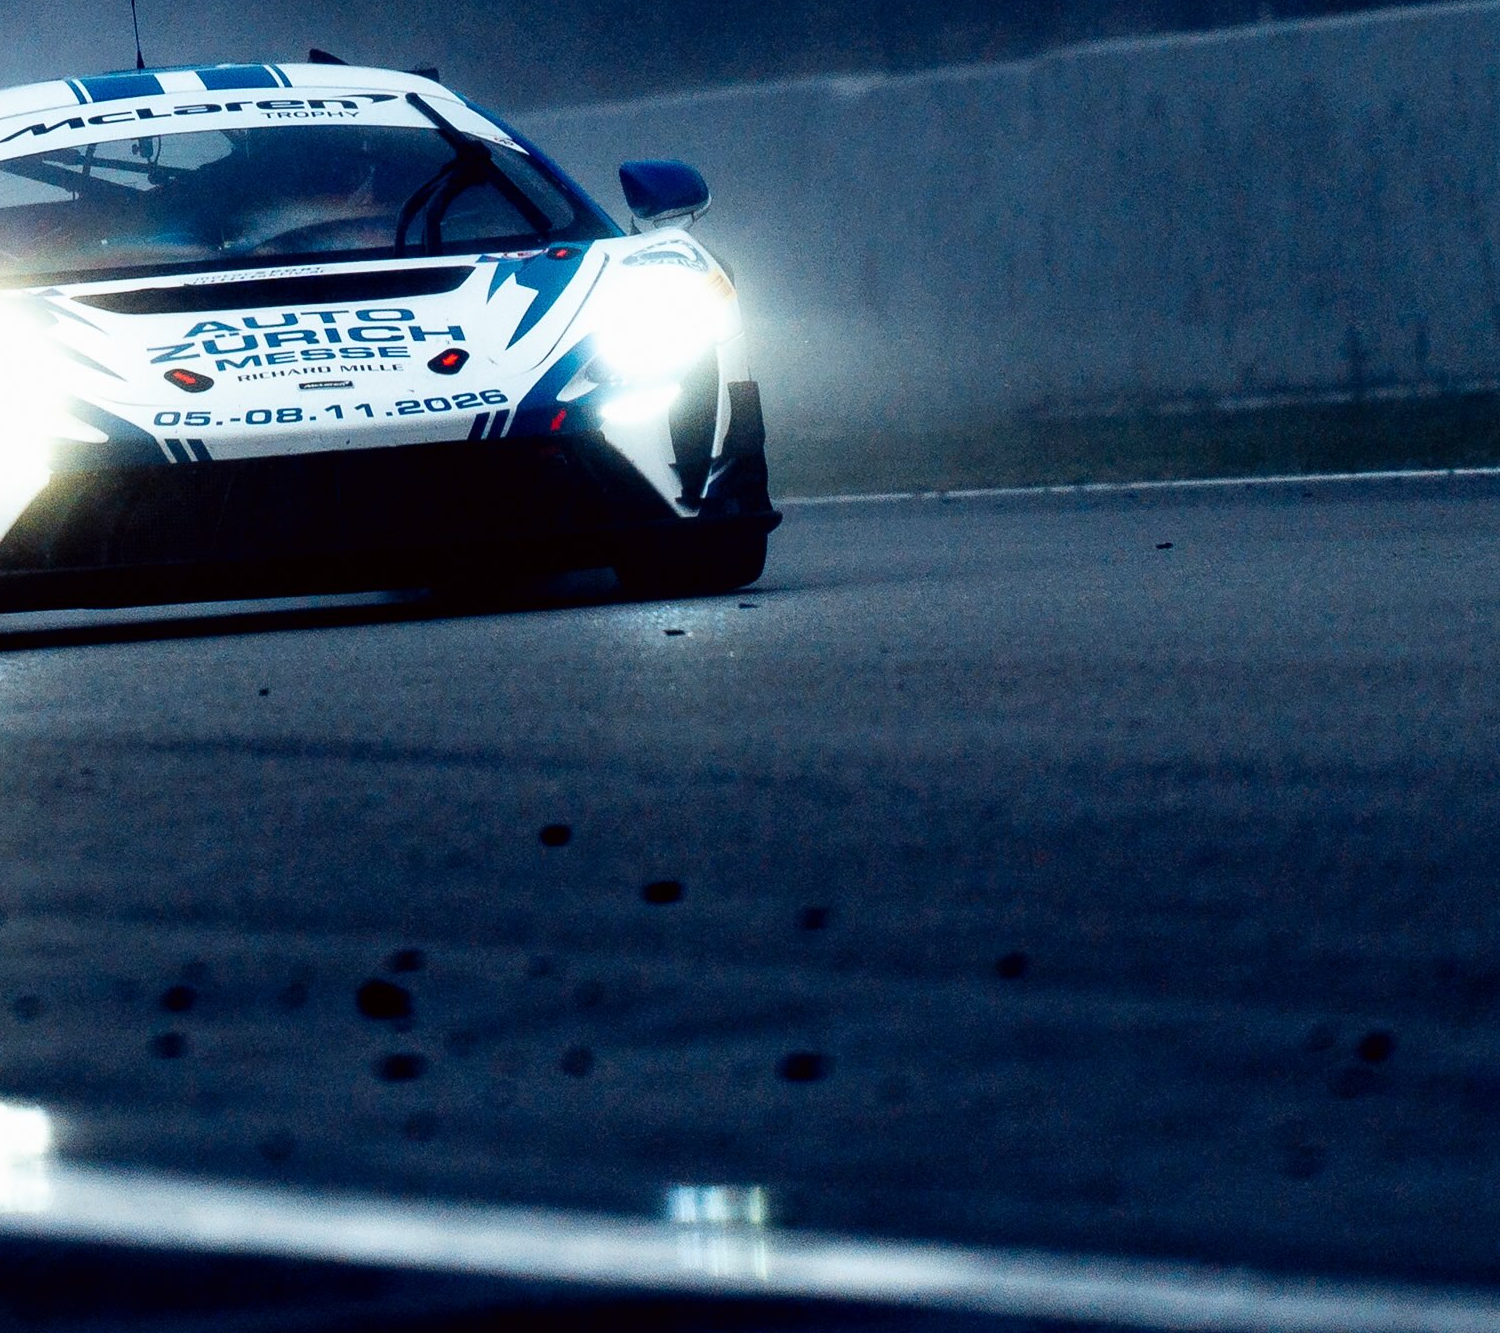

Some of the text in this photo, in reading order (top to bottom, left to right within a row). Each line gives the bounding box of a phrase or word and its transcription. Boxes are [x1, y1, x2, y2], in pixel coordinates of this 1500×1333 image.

[260, 110, 360, 120] TROPHY
[183, 308, 416, 338] AUTO
[146, 325, 466, 364] ZÜRICH
[215, 346, 412, 372] MESSE
[237, 364, 404, 382] RICHARD MILLE
[153, 389, 510, 427] 05.-08.11.2026
